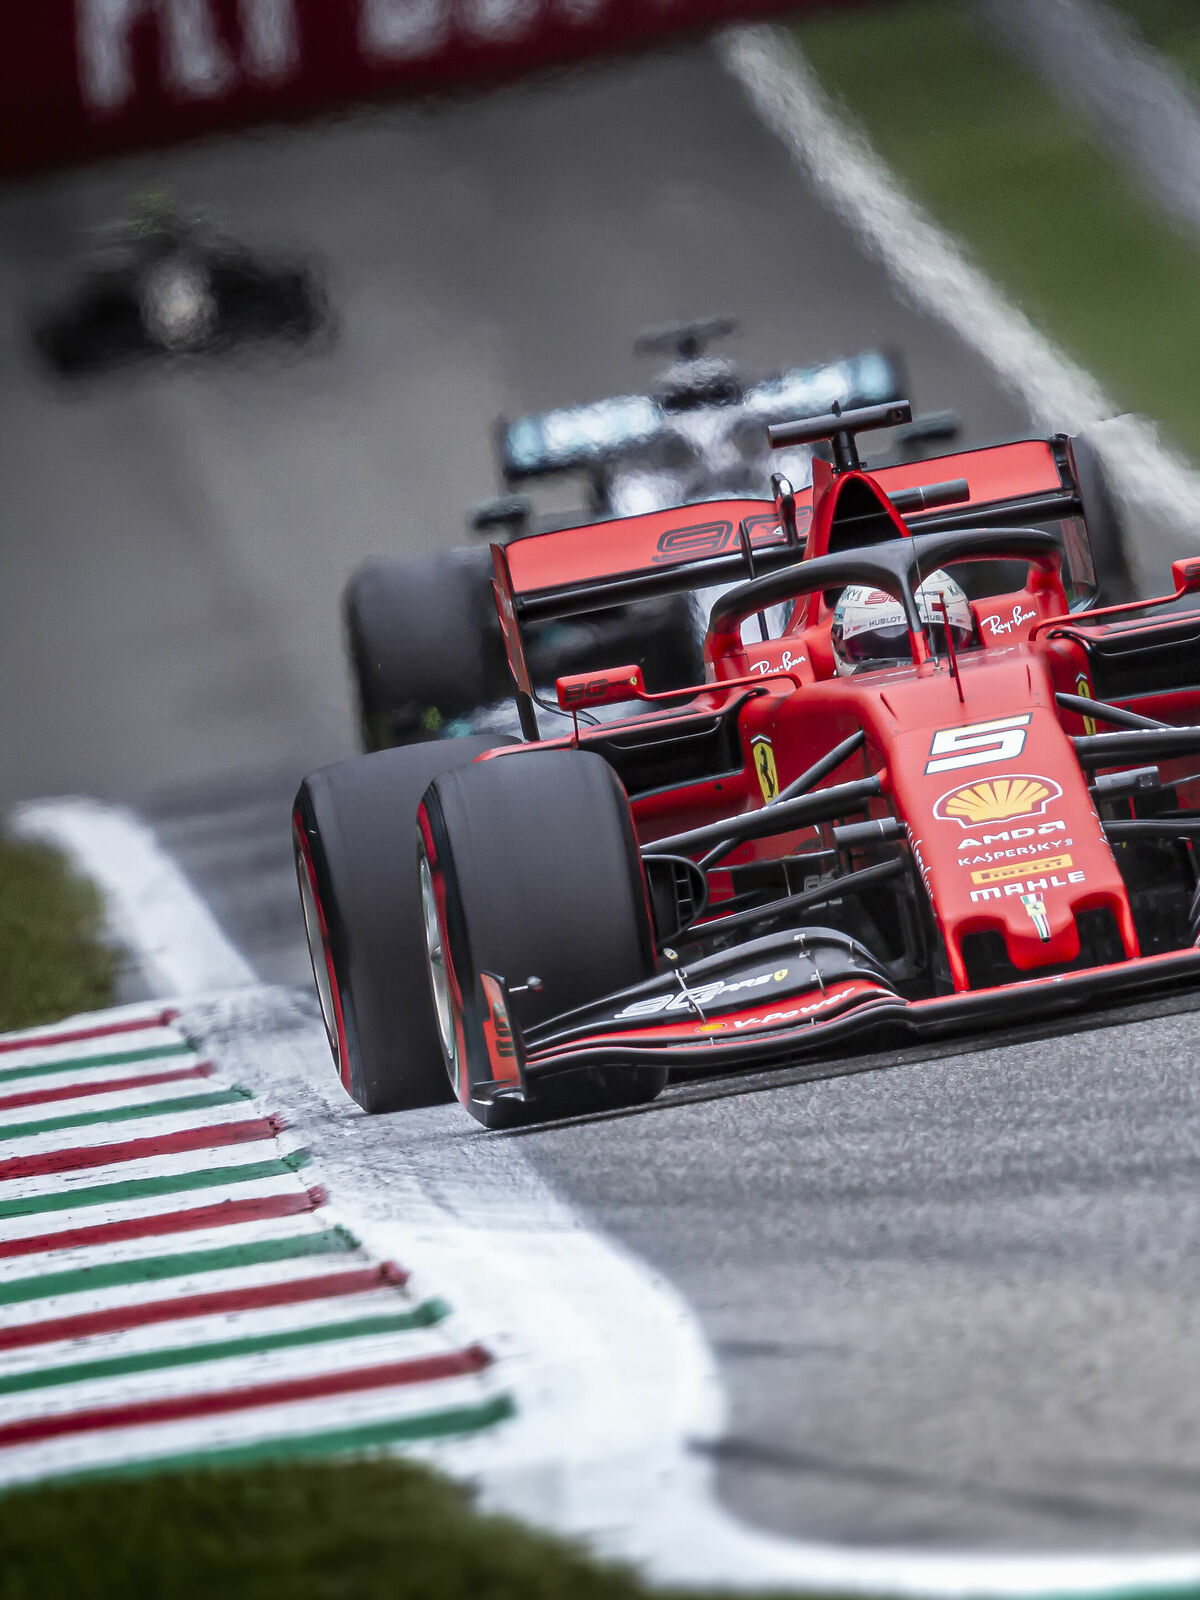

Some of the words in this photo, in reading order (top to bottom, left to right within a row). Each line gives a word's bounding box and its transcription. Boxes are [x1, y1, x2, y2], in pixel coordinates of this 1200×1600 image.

[868, 615, 901, 627] HUBLOT
[980, 605, 1037, 635] Ray-Ban
[924, 712, 1033, 776] 5
[957, 839, 1062, 867] KASPERSKY
[969, 870, 1086, 903] MAHLE
[734, 987, 855, 1029] V-Power
